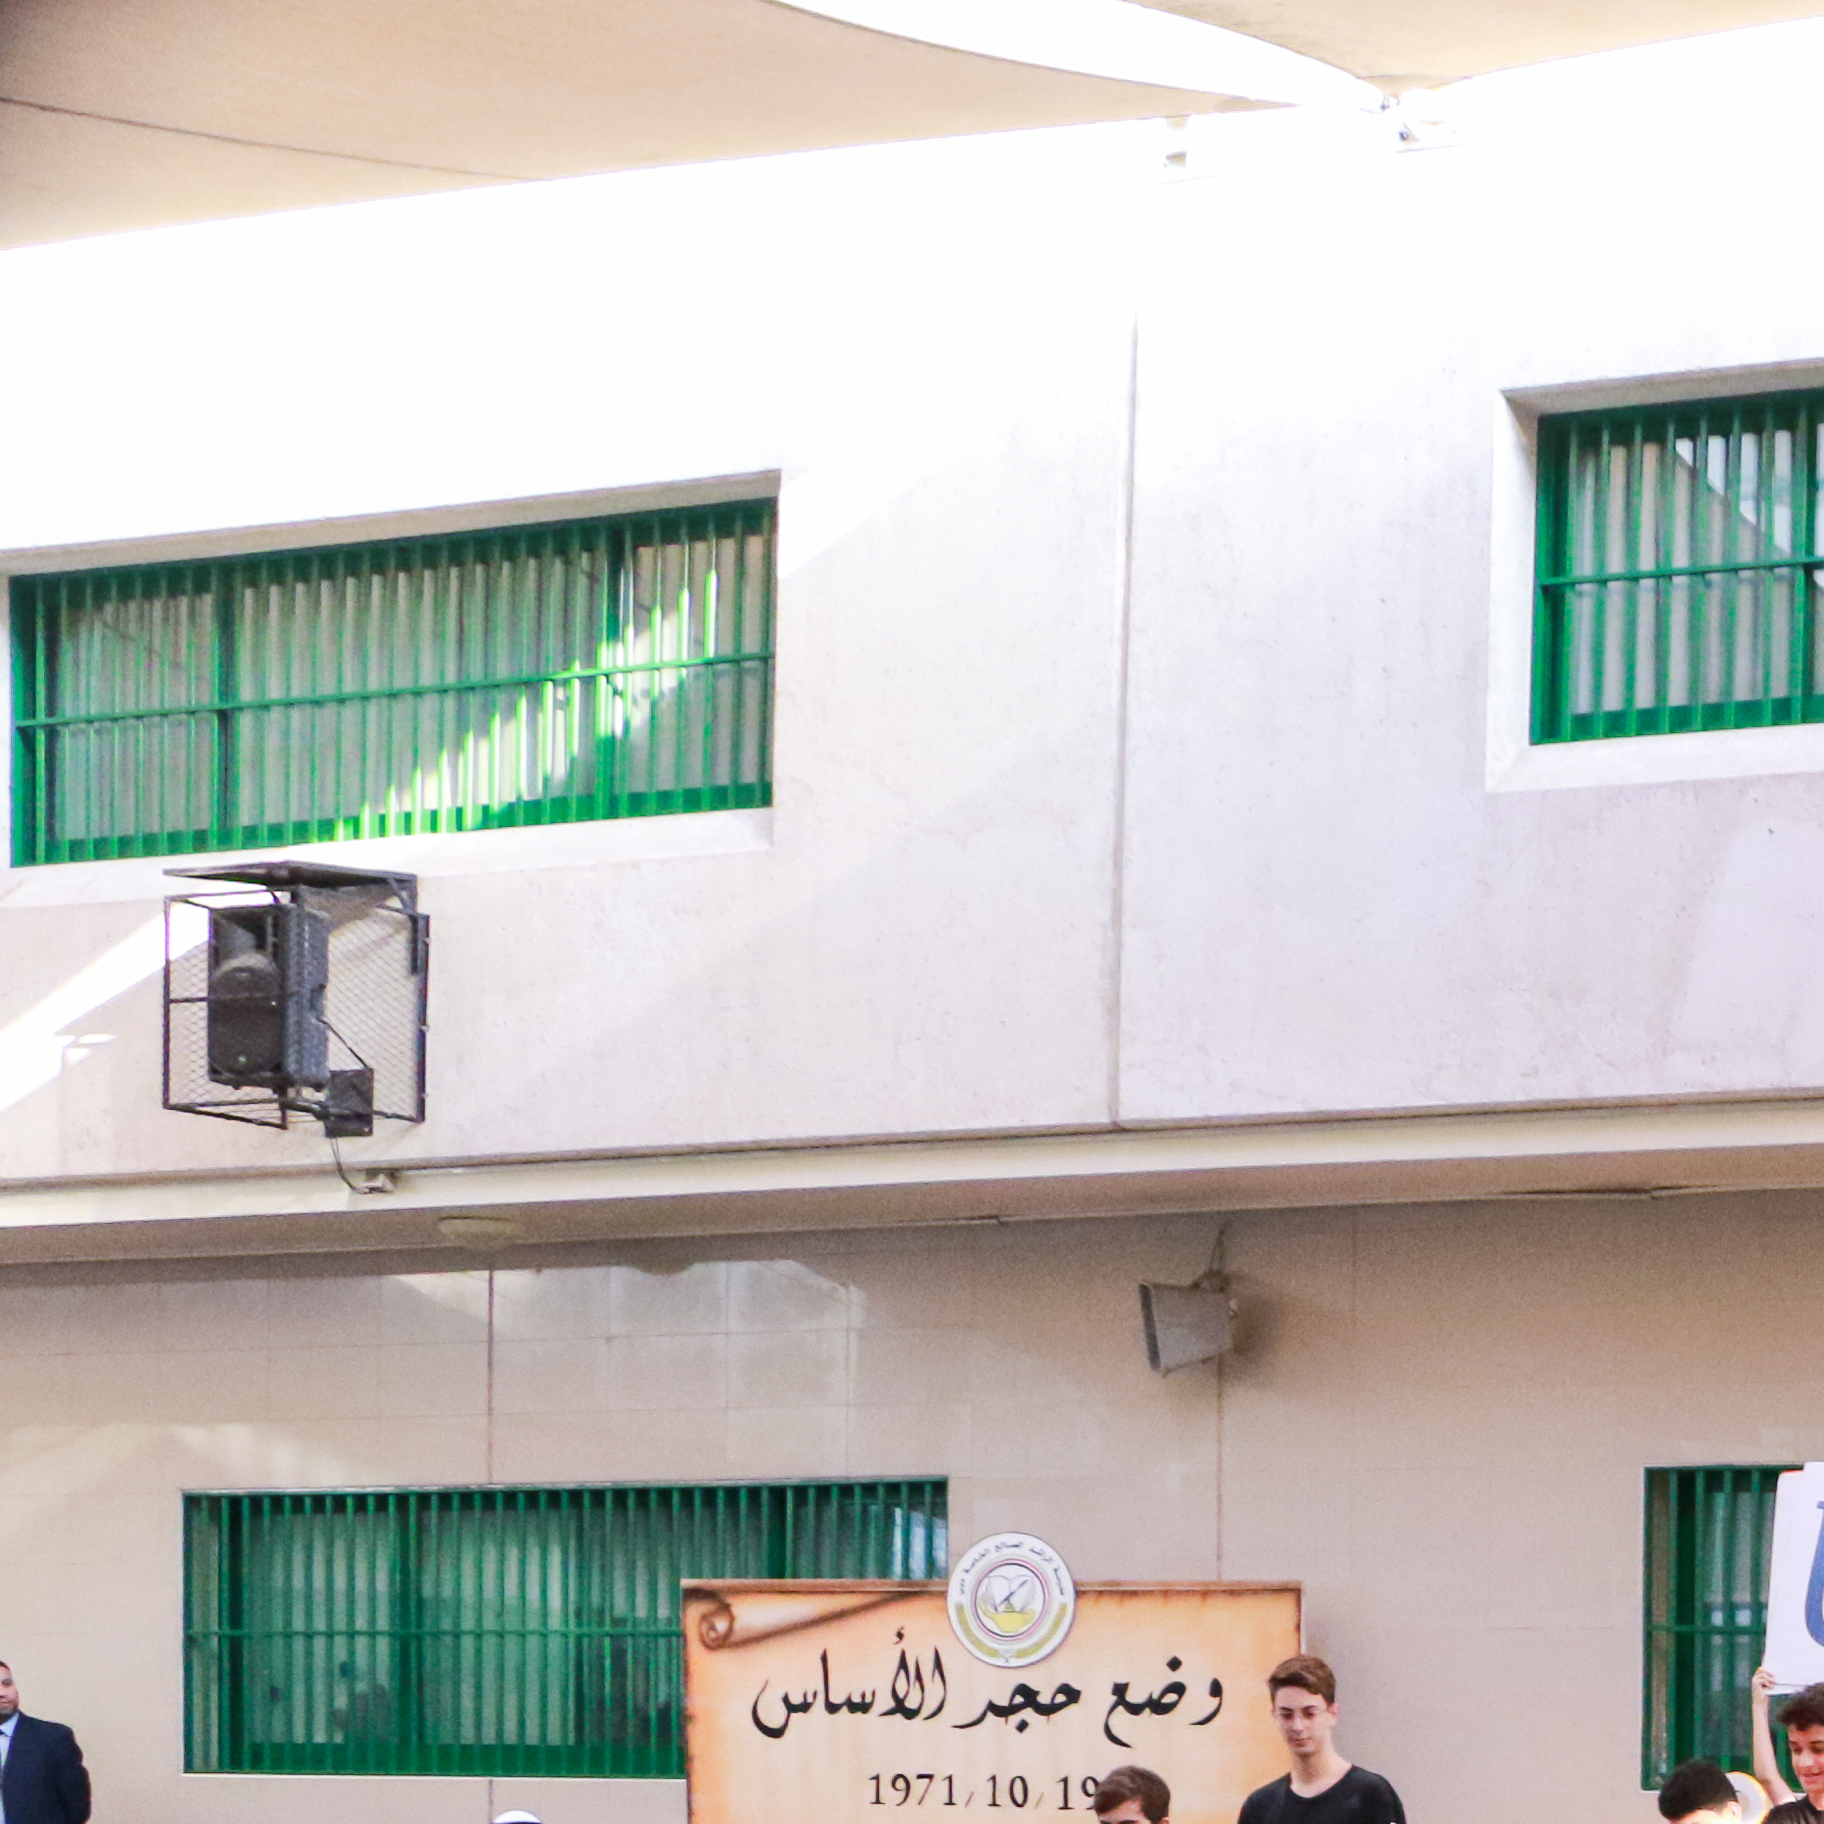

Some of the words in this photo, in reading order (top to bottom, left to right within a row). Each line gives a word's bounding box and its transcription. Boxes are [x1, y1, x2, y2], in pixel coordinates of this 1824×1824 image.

[751, 1626, 947, 1739] الأساس
[950, 1680, 1083, 1735] حجر
[1102, 1655, 1225, 1749] وضع
